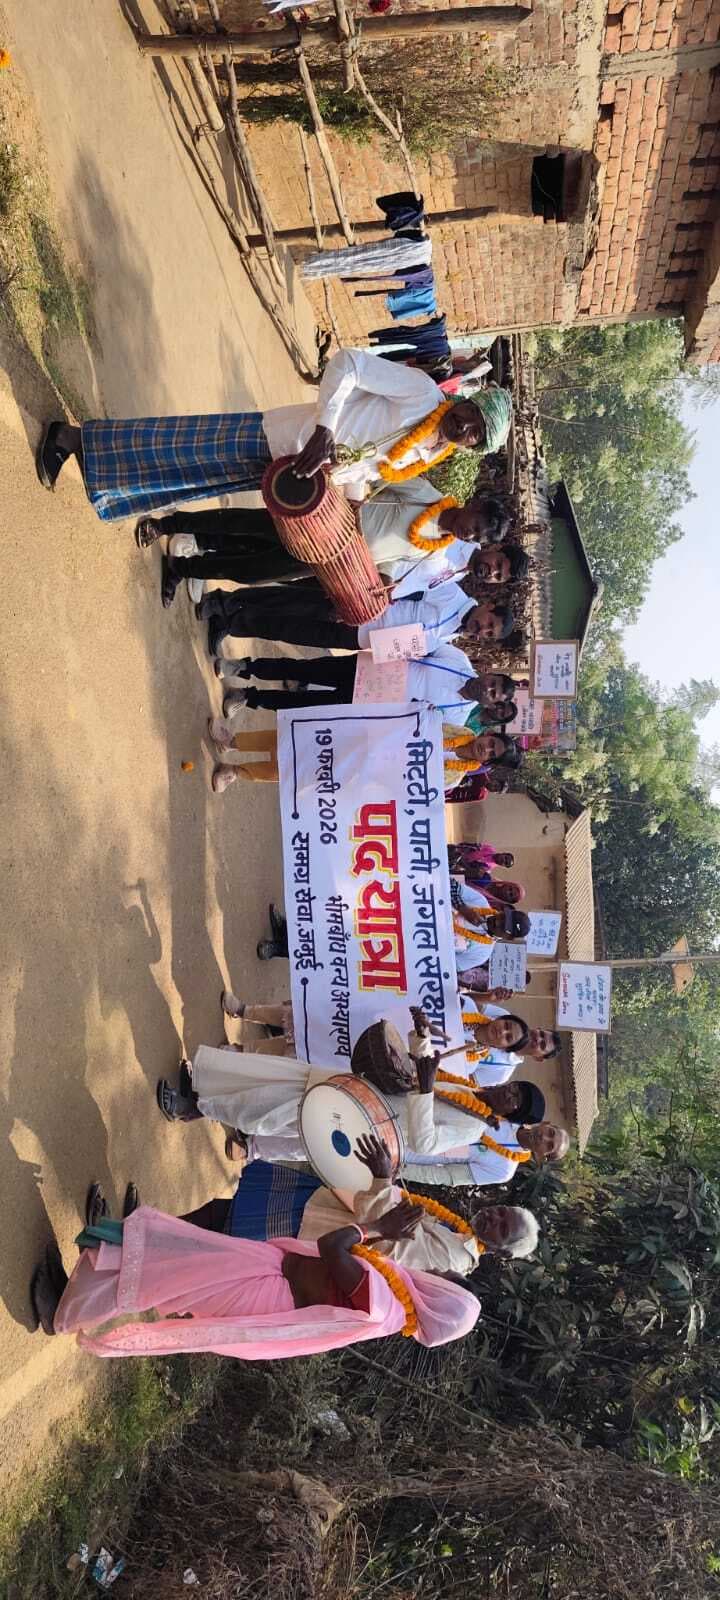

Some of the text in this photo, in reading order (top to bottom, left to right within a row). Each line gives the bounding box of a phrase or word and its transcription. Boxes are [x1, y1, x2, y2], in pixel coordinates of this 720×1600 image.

[315, 728, 340, 845] 19 फरवरी 2026
[292, 830, 310, 884] समग्र
[325, 895, 351, 954] भीमबाँध
[352, 799, 408, 994] पद यात्रा
[412, 884, 444, 952] जंगल
[330, 957, 348, 988] वन्य
